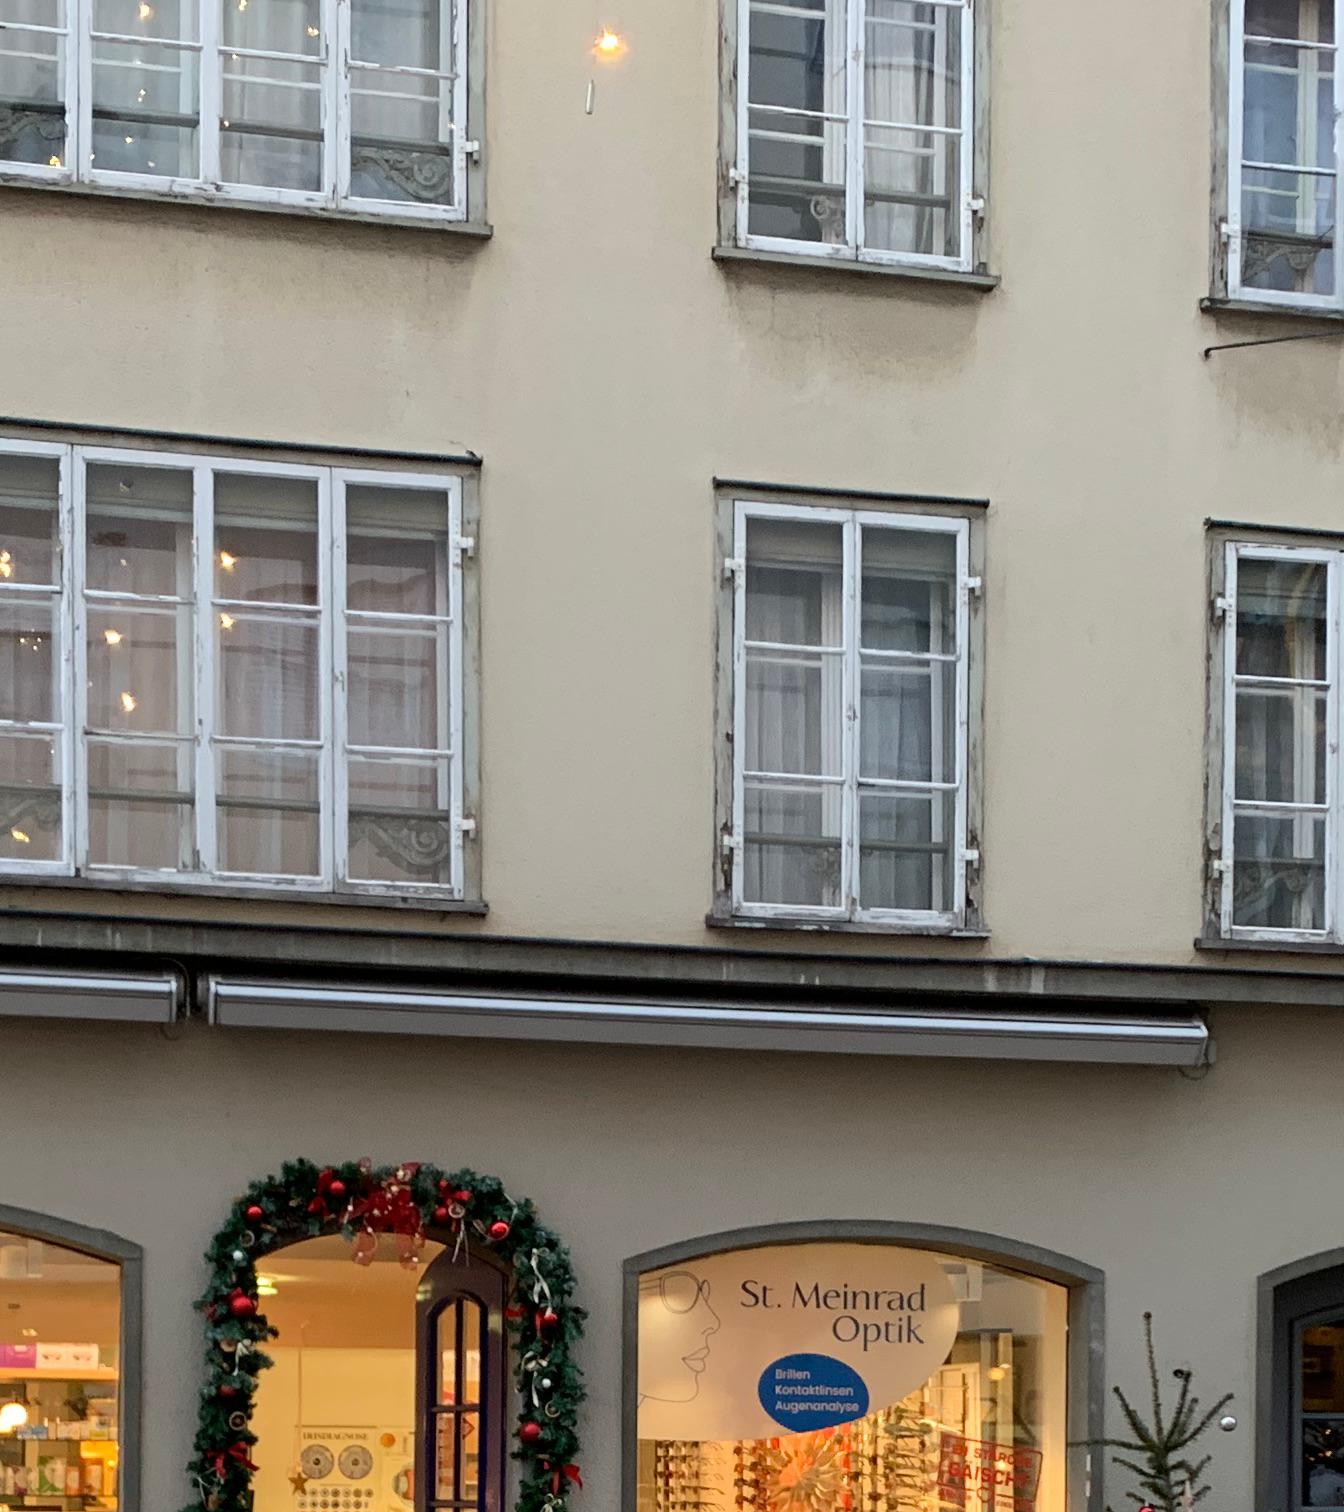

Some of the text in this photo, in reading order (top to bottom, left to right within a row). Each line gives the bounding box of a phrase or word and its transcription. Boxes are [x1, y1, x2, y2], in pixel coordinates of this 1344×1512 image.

[739, 1279, 926, 1312] St. Meinrad
[832, 1314, 925, 1352] Optik
[774, 1368, 811, 1381] Brillen
[774, 1384, 854, 1397] Kontaktlinsen
[774, 1400, 860, 1415] Augenanalyse
